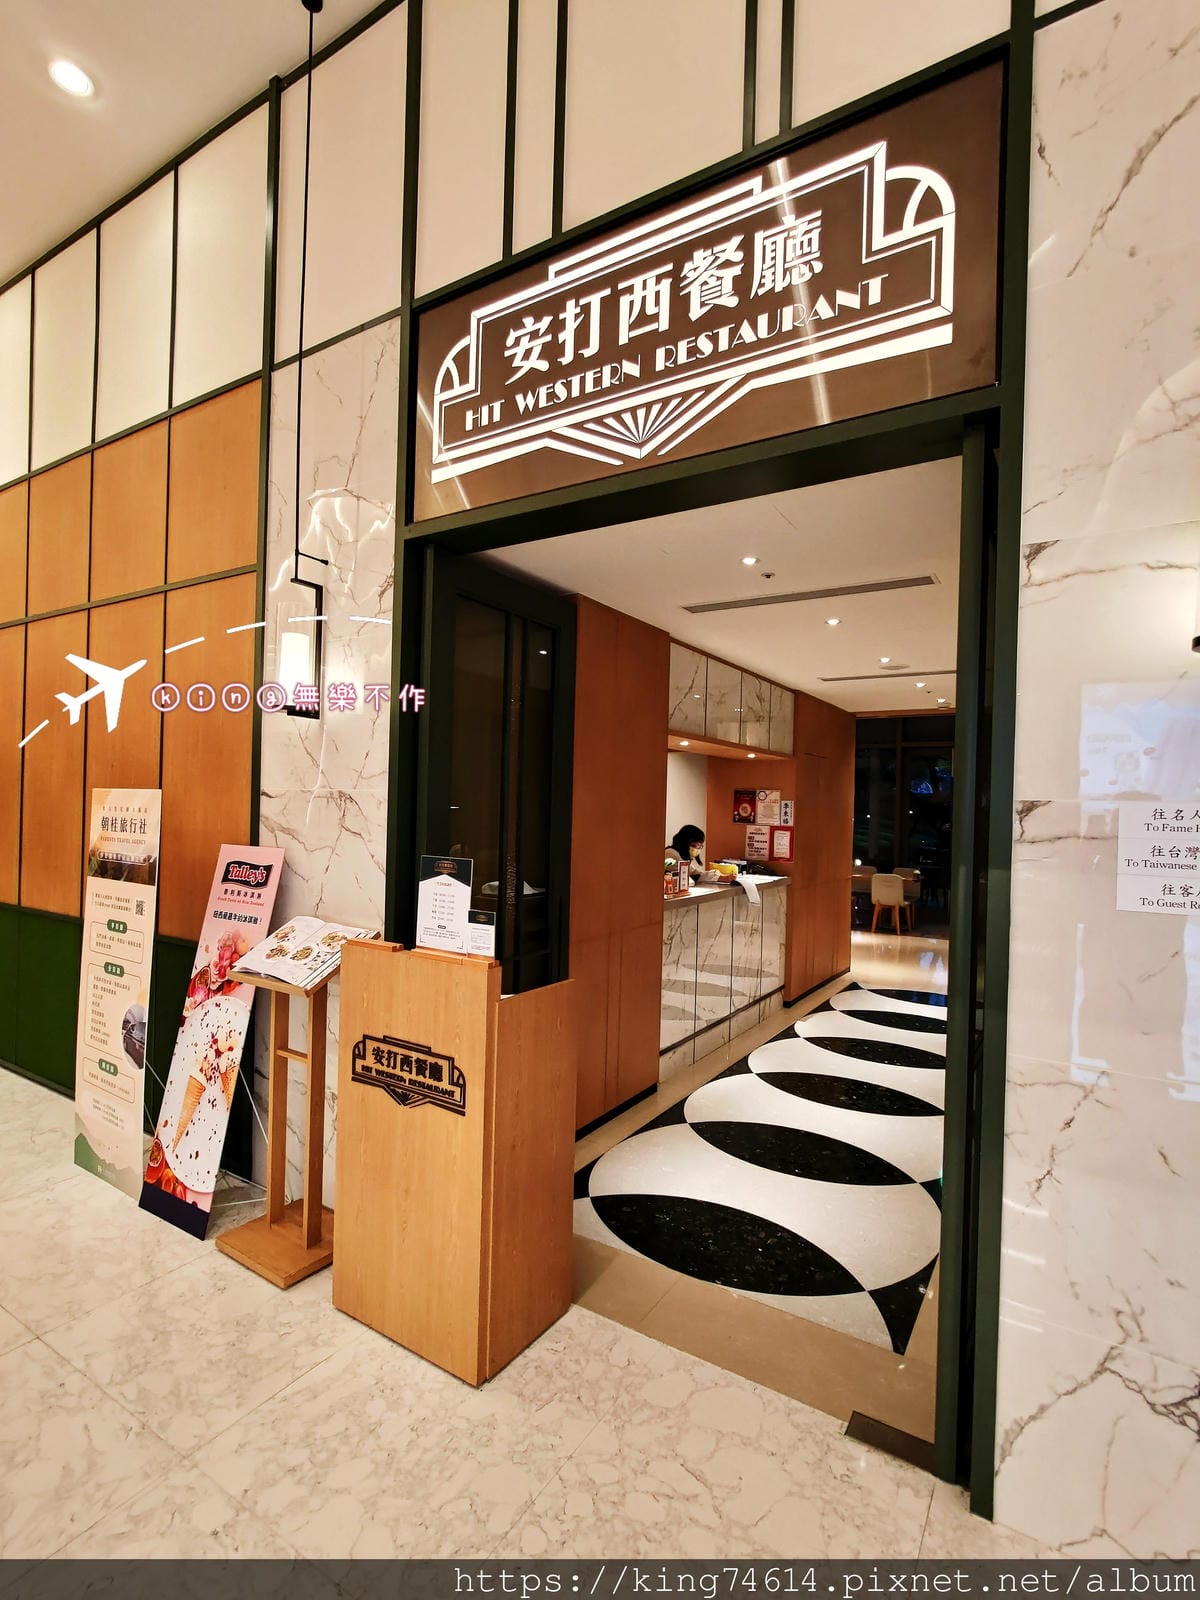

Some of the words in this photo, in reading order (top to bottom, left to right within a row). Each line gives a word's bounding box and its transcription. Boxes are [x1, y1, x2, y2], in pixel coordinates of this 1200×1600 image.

[504, 210, 824, 385] 安打西餐廳
[465, 400, 505, 432] HIT
[515, 354, 641, 415] WESTERN
[656, 273, 889, 370] RESTAURANT
[1144, 823, 1159, 832] To
[1162, 823, 1193, 833] Fame
[229, 864, 266, 885] Talley's
[1124, 859, 1139, 867] To
[1141, 859, 1197, 871] Taiwanese
[1161, 883, 1200, 898] 往客
[1139, 897, 1154, 906] To
[1156, 898, 1187, 909] Guest
[372, 1046, 443, 1082] 安打西餐廳
[408, 1078, 456, 1098] RESTAURANT
